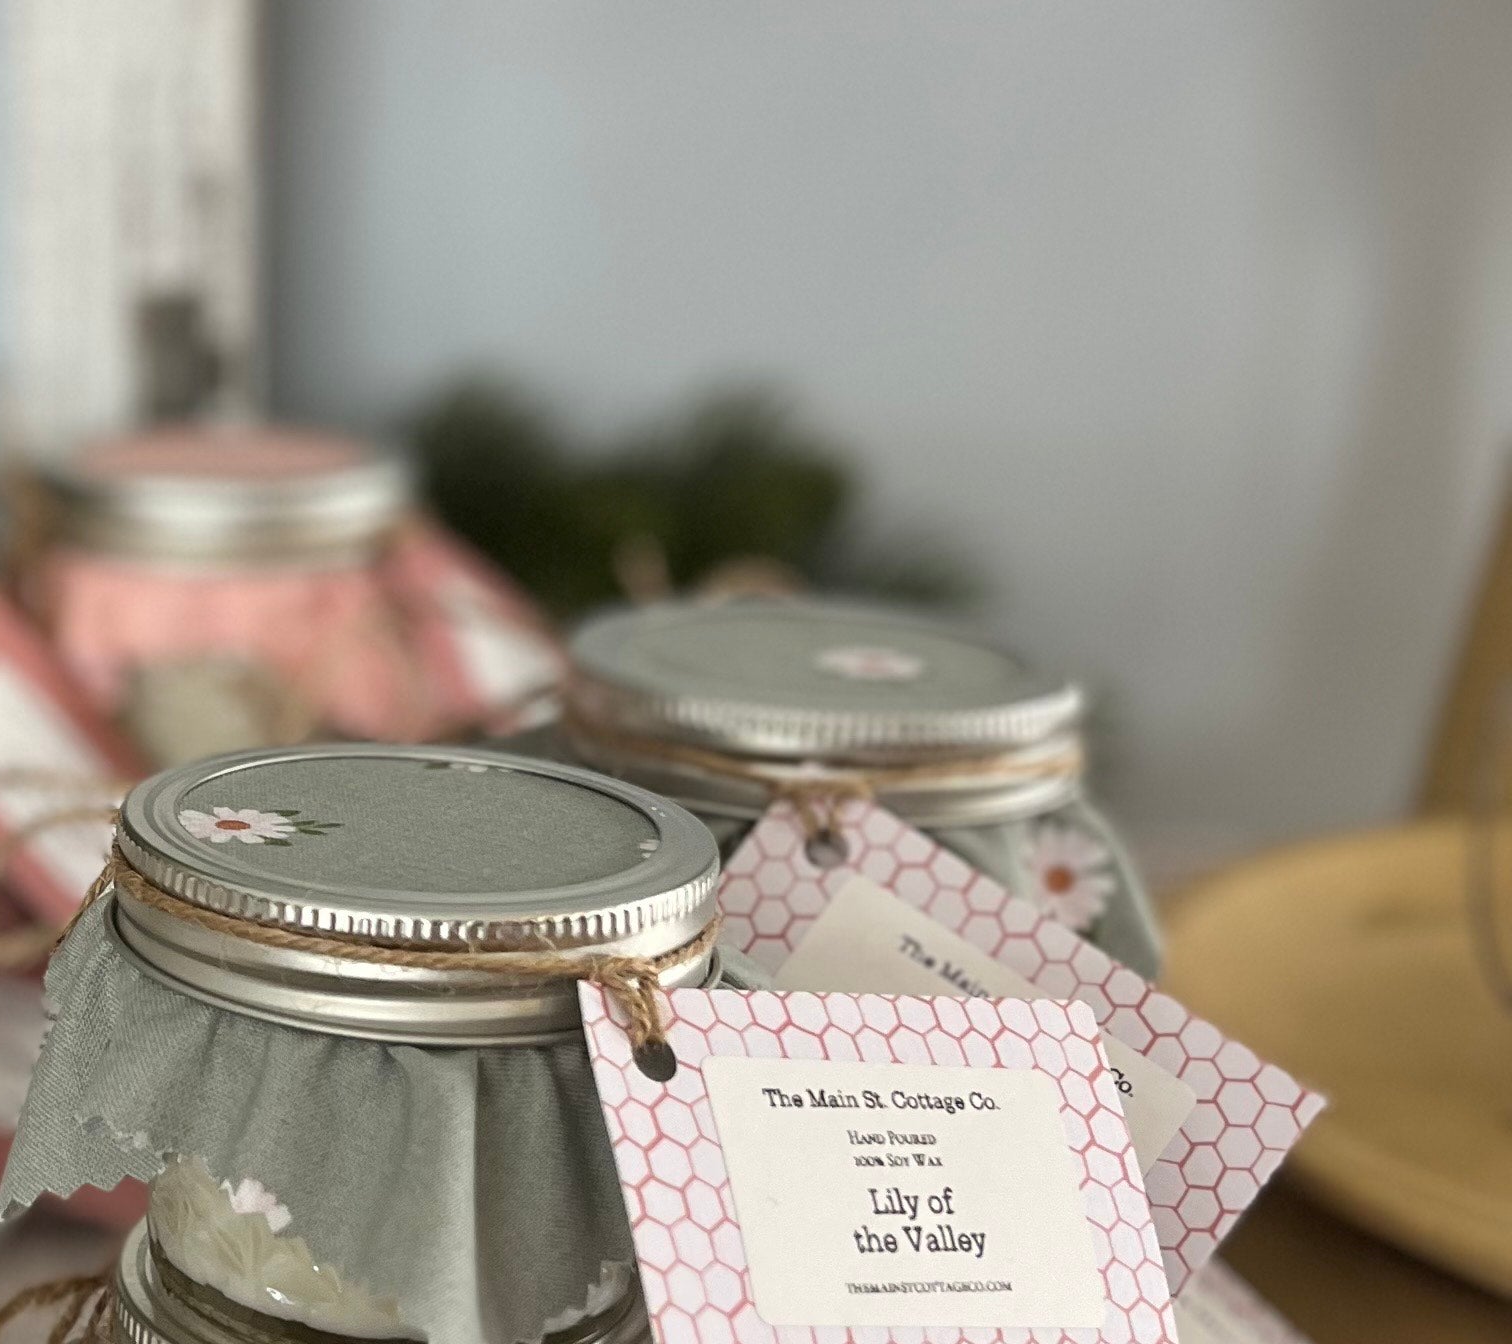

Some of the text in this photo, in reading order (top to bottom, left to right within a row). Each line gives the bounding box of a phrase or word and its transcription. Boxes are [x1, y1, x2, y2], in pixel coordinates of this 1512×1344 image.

[762, 1088, 1001, 1115] The Main St. Cottage Co.
[868, 1187, 955, 1220] Lily of
[854, 1226, 986, 1258] the Valley
